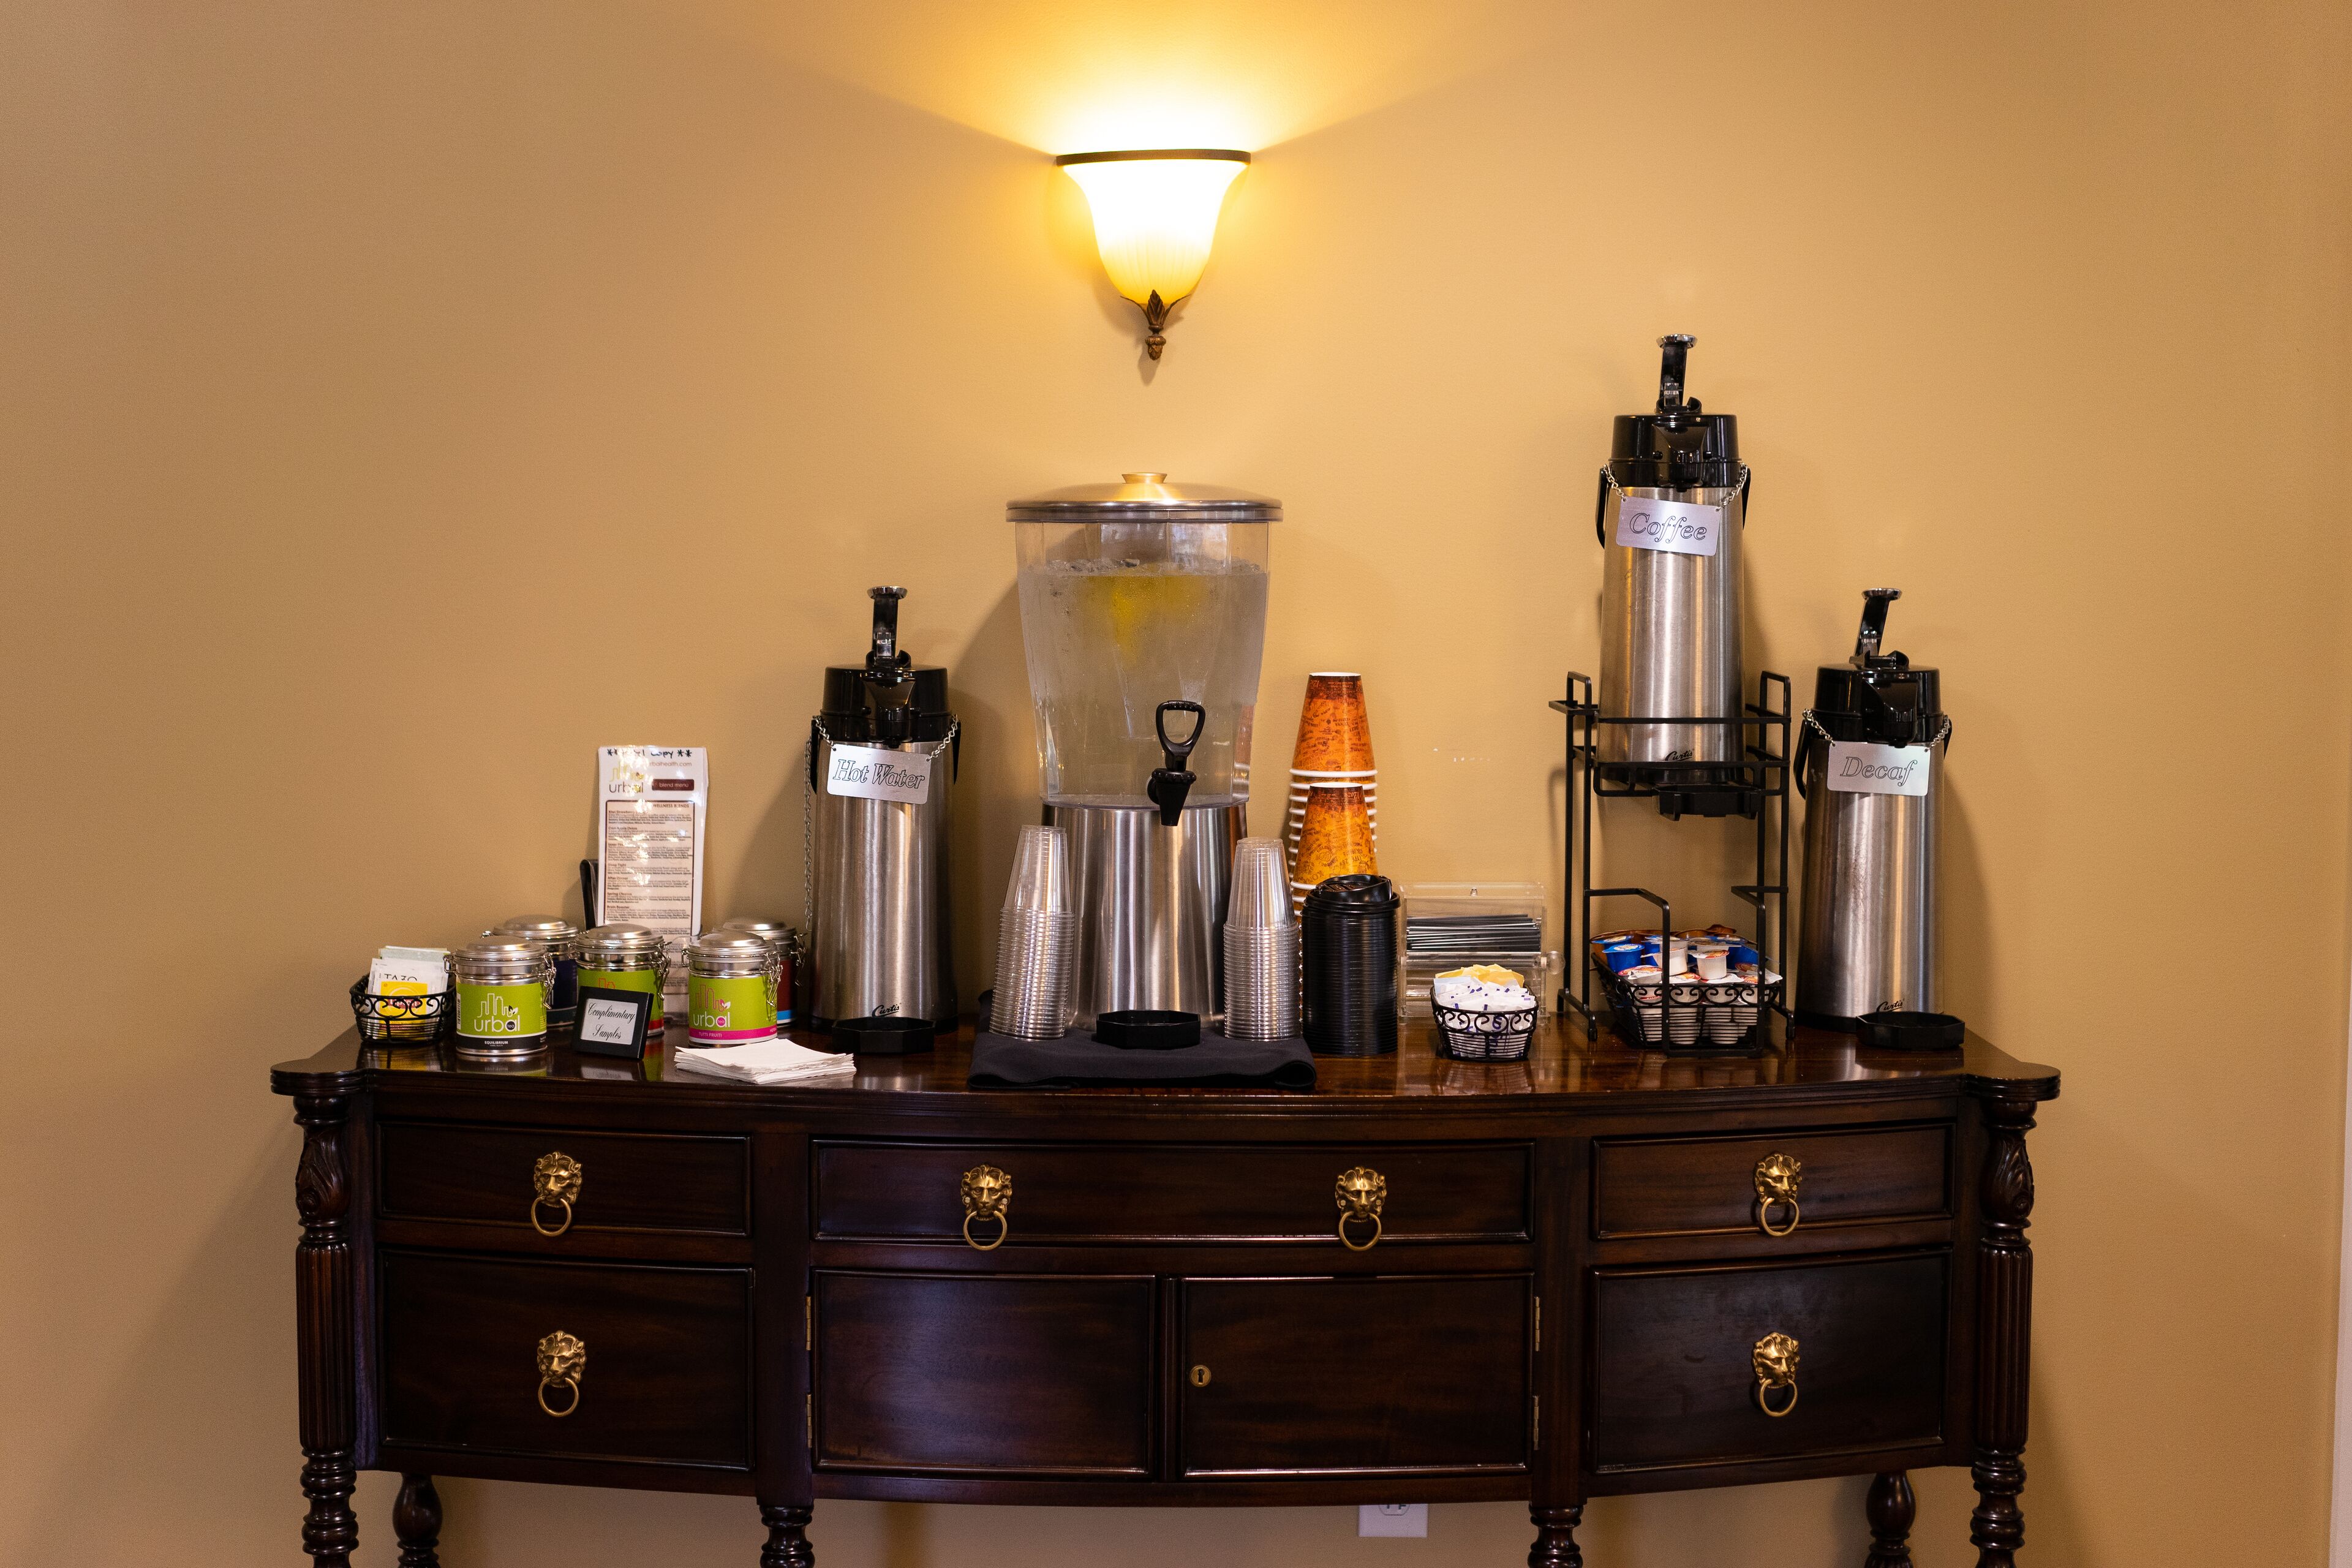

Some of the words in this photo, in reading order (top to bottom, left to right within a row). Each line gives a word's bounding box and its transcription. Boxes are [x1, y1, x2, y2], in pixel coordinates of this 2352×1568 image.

[1629, 512, 1707, 544] Coffee
[1665, 750, 1693, 761] Curtis
[832, 759, 869, 783] Hot
[872, 763, 925, 789] Water
[1839, 756, 1918, 787] Decaf
[587, 1002, 635, 1024] Complimentary
[872, 1003, 900, 1017] Curtis
[1876, 1001, 1903, 1012] Curtis
[474, 1015, 520, 1033] urbal
[693, 1011, 730, 1028] urbal
[592, 1024, 621, 1041] Samples
